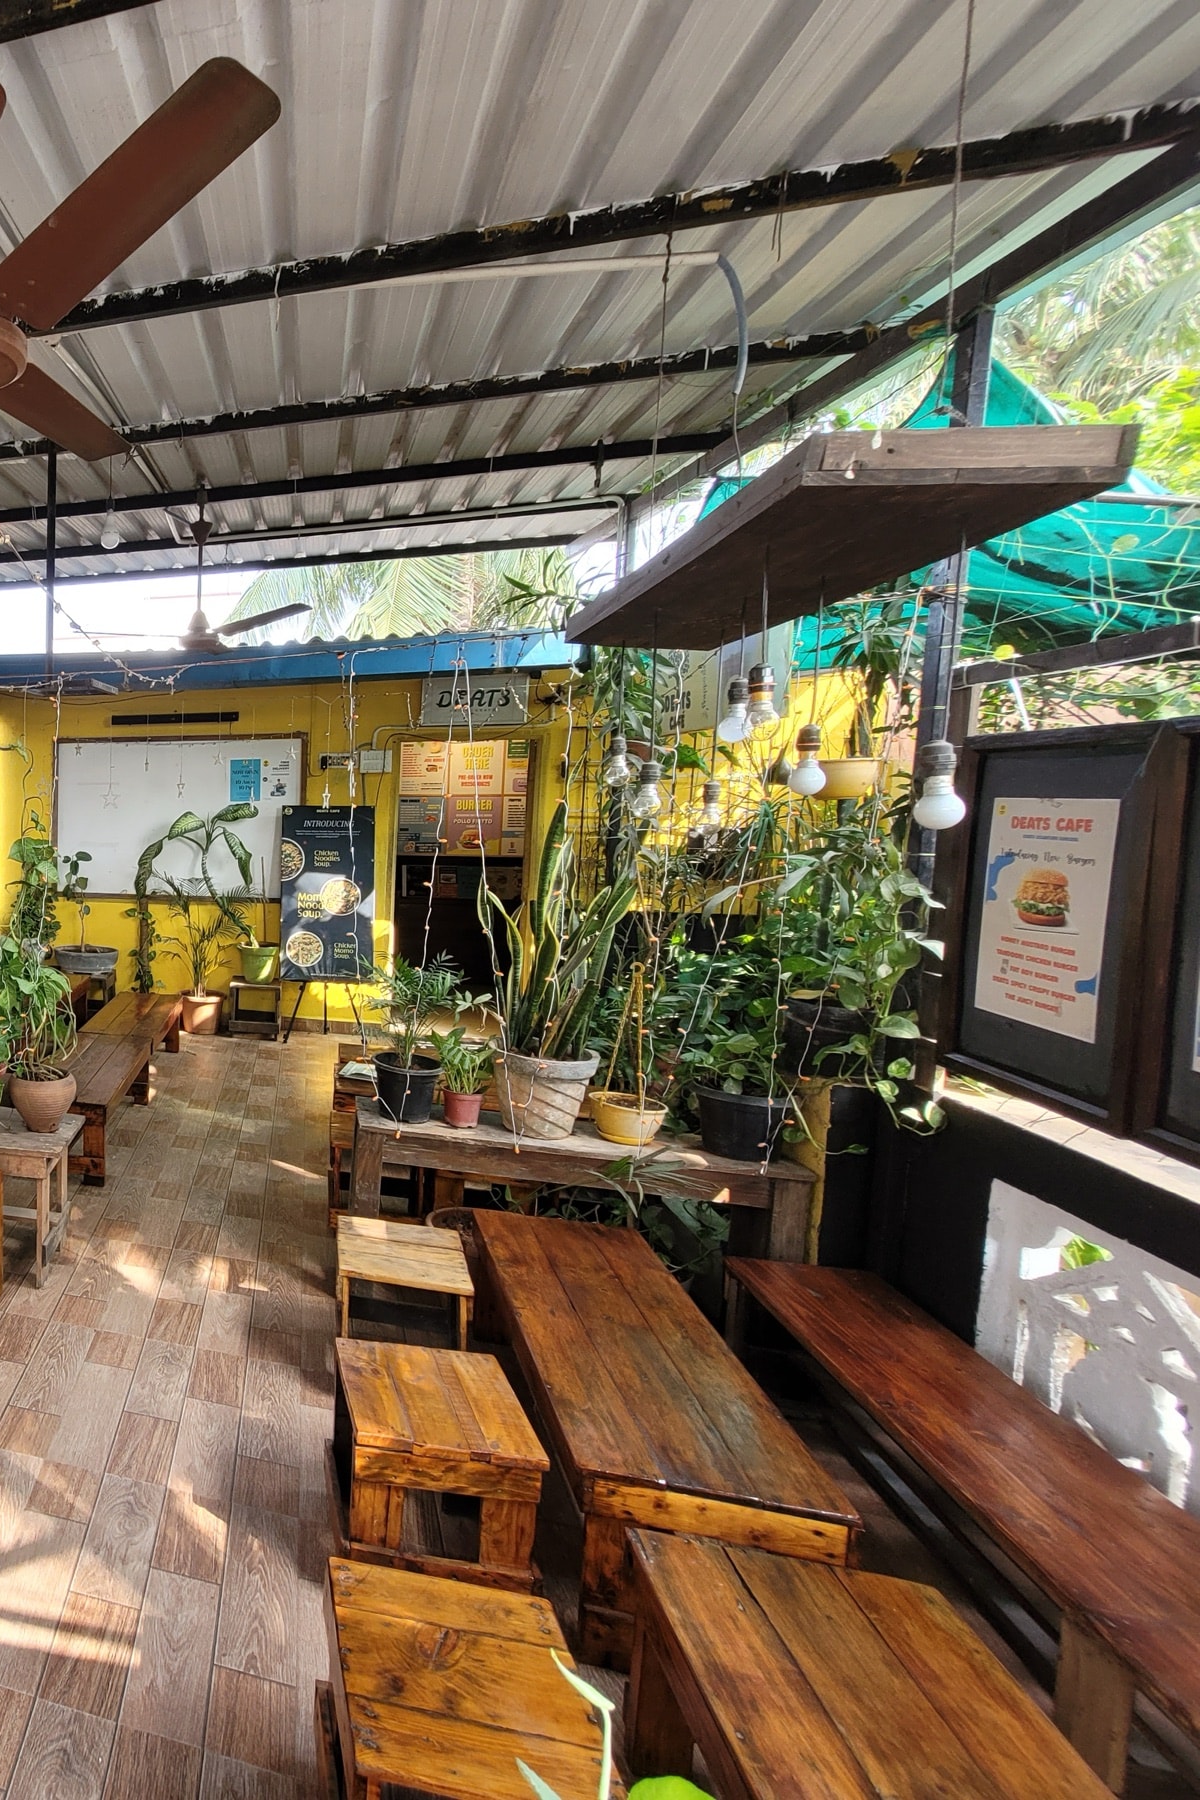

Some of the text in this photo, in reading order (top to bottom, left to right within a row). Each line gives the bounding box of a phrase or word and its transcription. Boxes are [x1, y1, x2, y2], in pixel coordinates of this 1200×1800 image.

[303, 820, 355, 828] INTRODUCING
[1011, 816, 1095, 833] DEATS CAFE
[297, 908, 323, 919] Soup.
